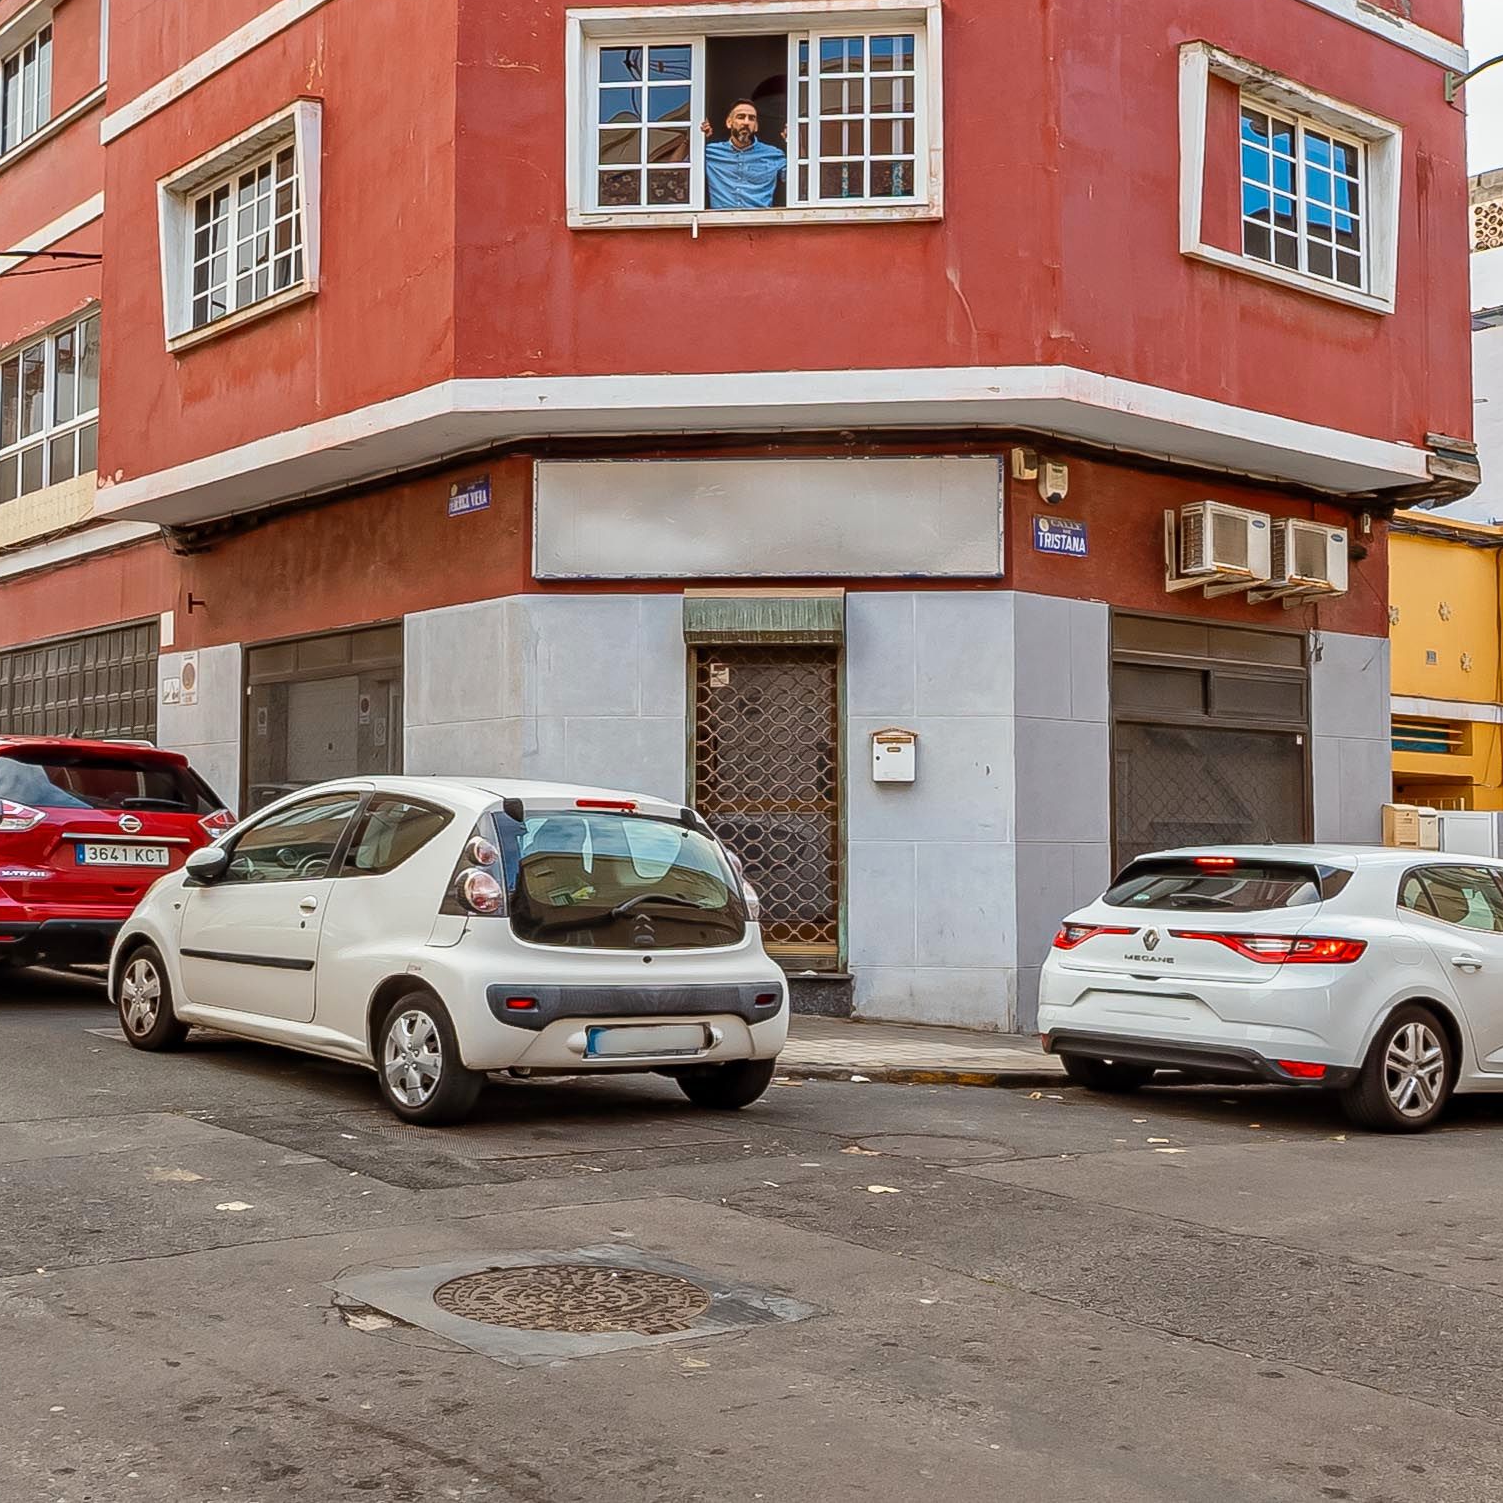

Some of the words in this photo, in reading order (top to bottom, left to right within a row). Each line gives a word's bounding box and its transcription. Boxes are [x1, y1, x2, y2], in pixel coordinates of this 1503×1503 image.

[1050, 519, 1083, 531] CALLE
[1038, 531, 1086, 553] TRISTANA
[88, 847, 129, 862] 3641
[135, 849, 165, 863] KCT
[1124, 954, 1175, 964] MEGANE
